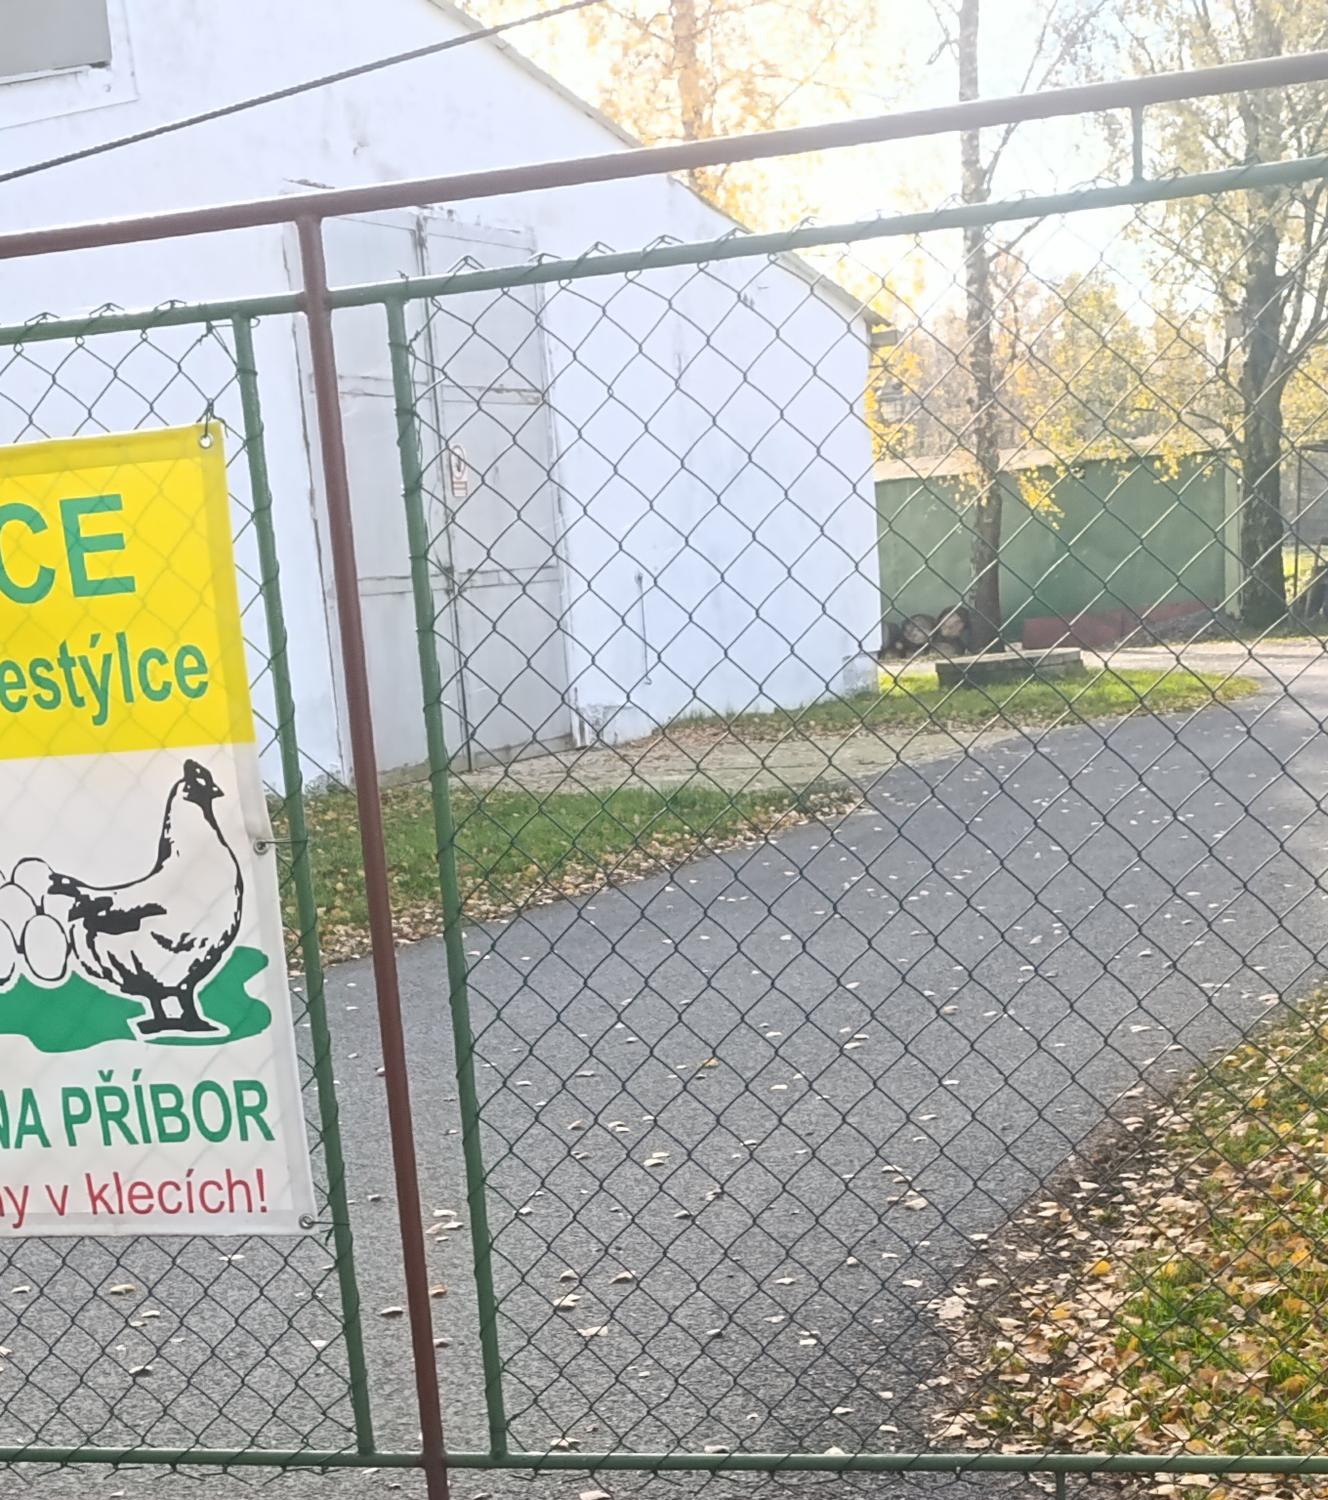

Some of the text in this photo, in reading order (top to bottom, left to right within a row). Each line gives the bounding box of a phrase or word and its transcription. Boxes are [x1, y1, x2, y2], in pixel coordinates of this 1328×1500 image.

[62, 1069, 274, 1147] PŘÍBOR
[45, 1183, 68, 1216] v
[85, 1168, 267, 1215] klecích!
